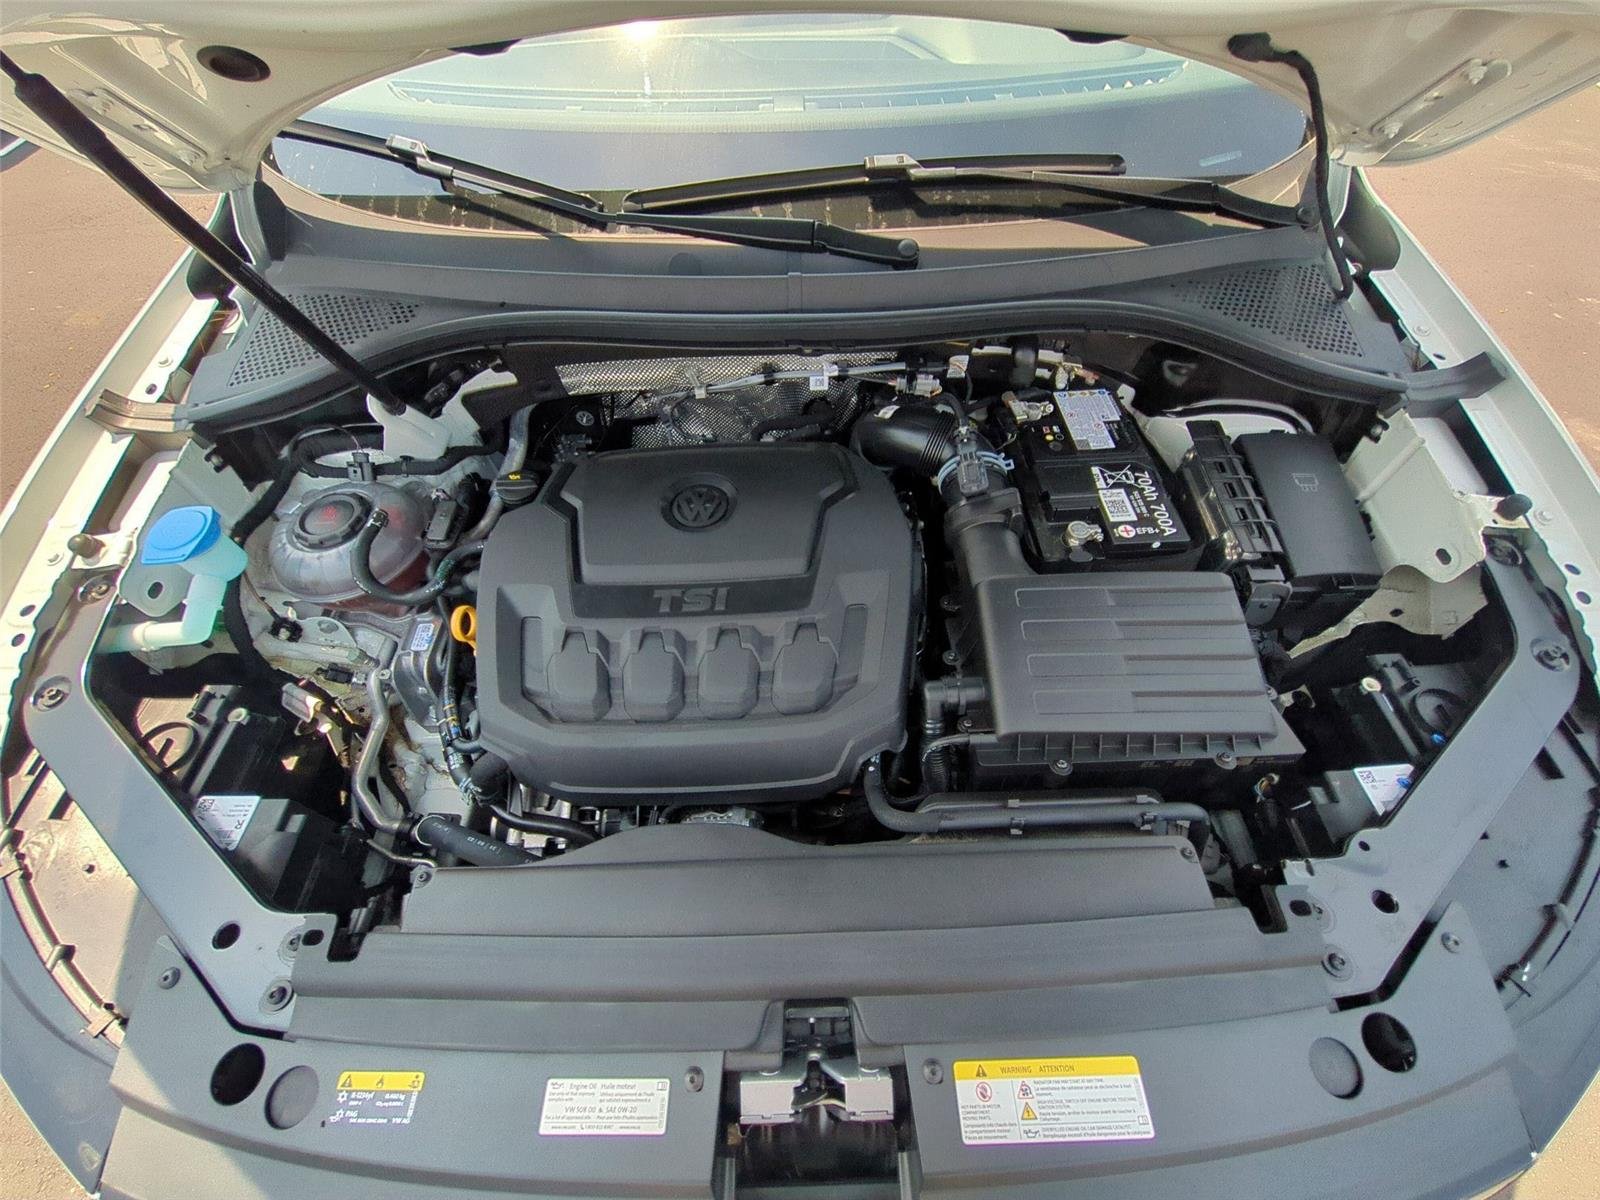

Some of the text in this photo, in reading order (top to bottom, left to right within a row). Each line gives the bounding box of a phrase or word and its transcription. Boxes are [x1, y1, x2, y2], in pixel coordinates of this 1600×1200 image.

[1134, 471, 1159, 501] 70Ah
[1150, 504, 1177, 536] 700A
[652, 586, 730, 614] TSI
[1000, 1064, 1075, 1074] WARNING ATTENTION
